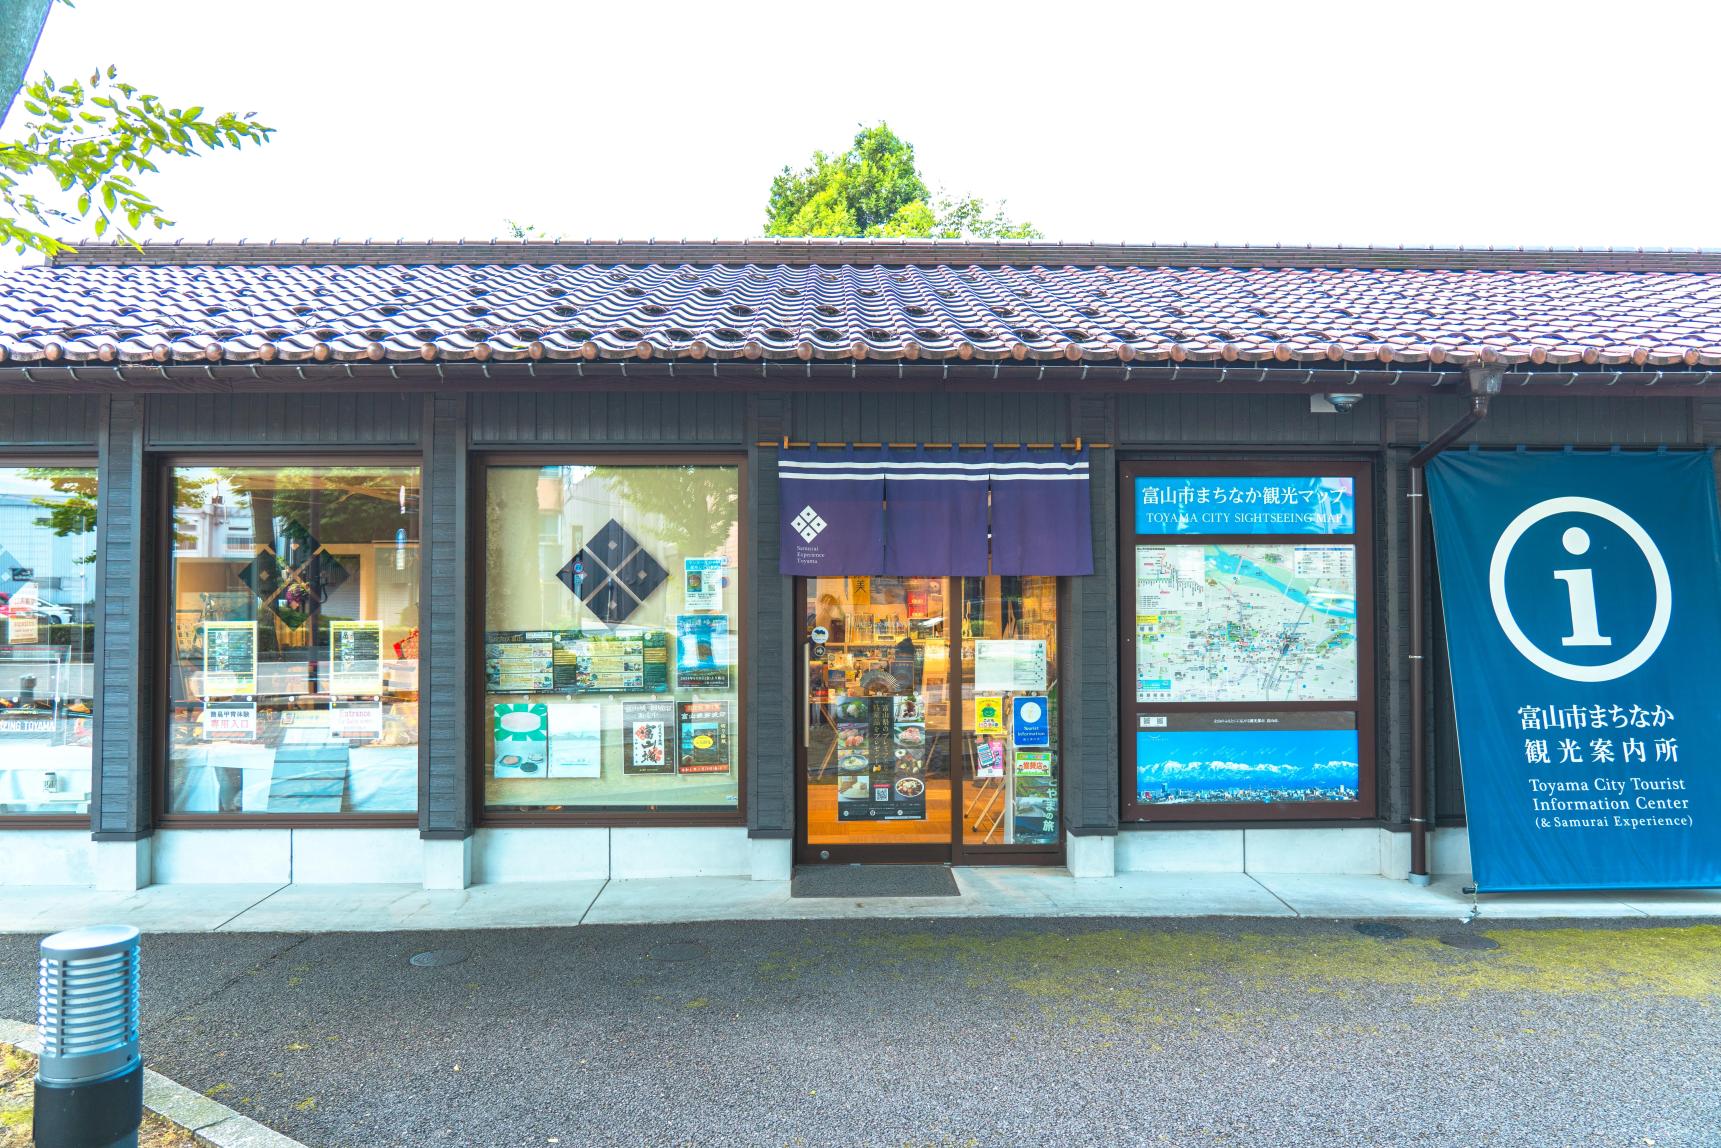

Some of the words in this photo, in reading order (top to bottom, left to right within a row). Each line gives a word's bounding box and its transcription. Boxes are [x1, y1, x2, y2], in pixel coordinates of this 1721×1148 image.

[1142, 486, 1346, 505] 富山市まちなか観光マップ
[1146, 513, 1198, 523] TOYAMA
[1202, 513, 1230, 523] CITY
[1234, 513, 1312, 523] SIGHTSEEING
[1316, 513, 1344, 523] MAP
[1517, 703, 1675, 730] 富山市まちなか
[1525, 737, 1679, 764] 観光案内所
[1528, 778, 1590, 796] Toyama
[1594, 778, 1626, 795] City
[1630, 777, 1687, 791] Tourist
[1533, 797, 1630, 811] Information
[1635, 796, 1689, 810] Center
[1554, 815, 1609, 828] Samurai
[1613, 815, 1694, 829] Experience)
